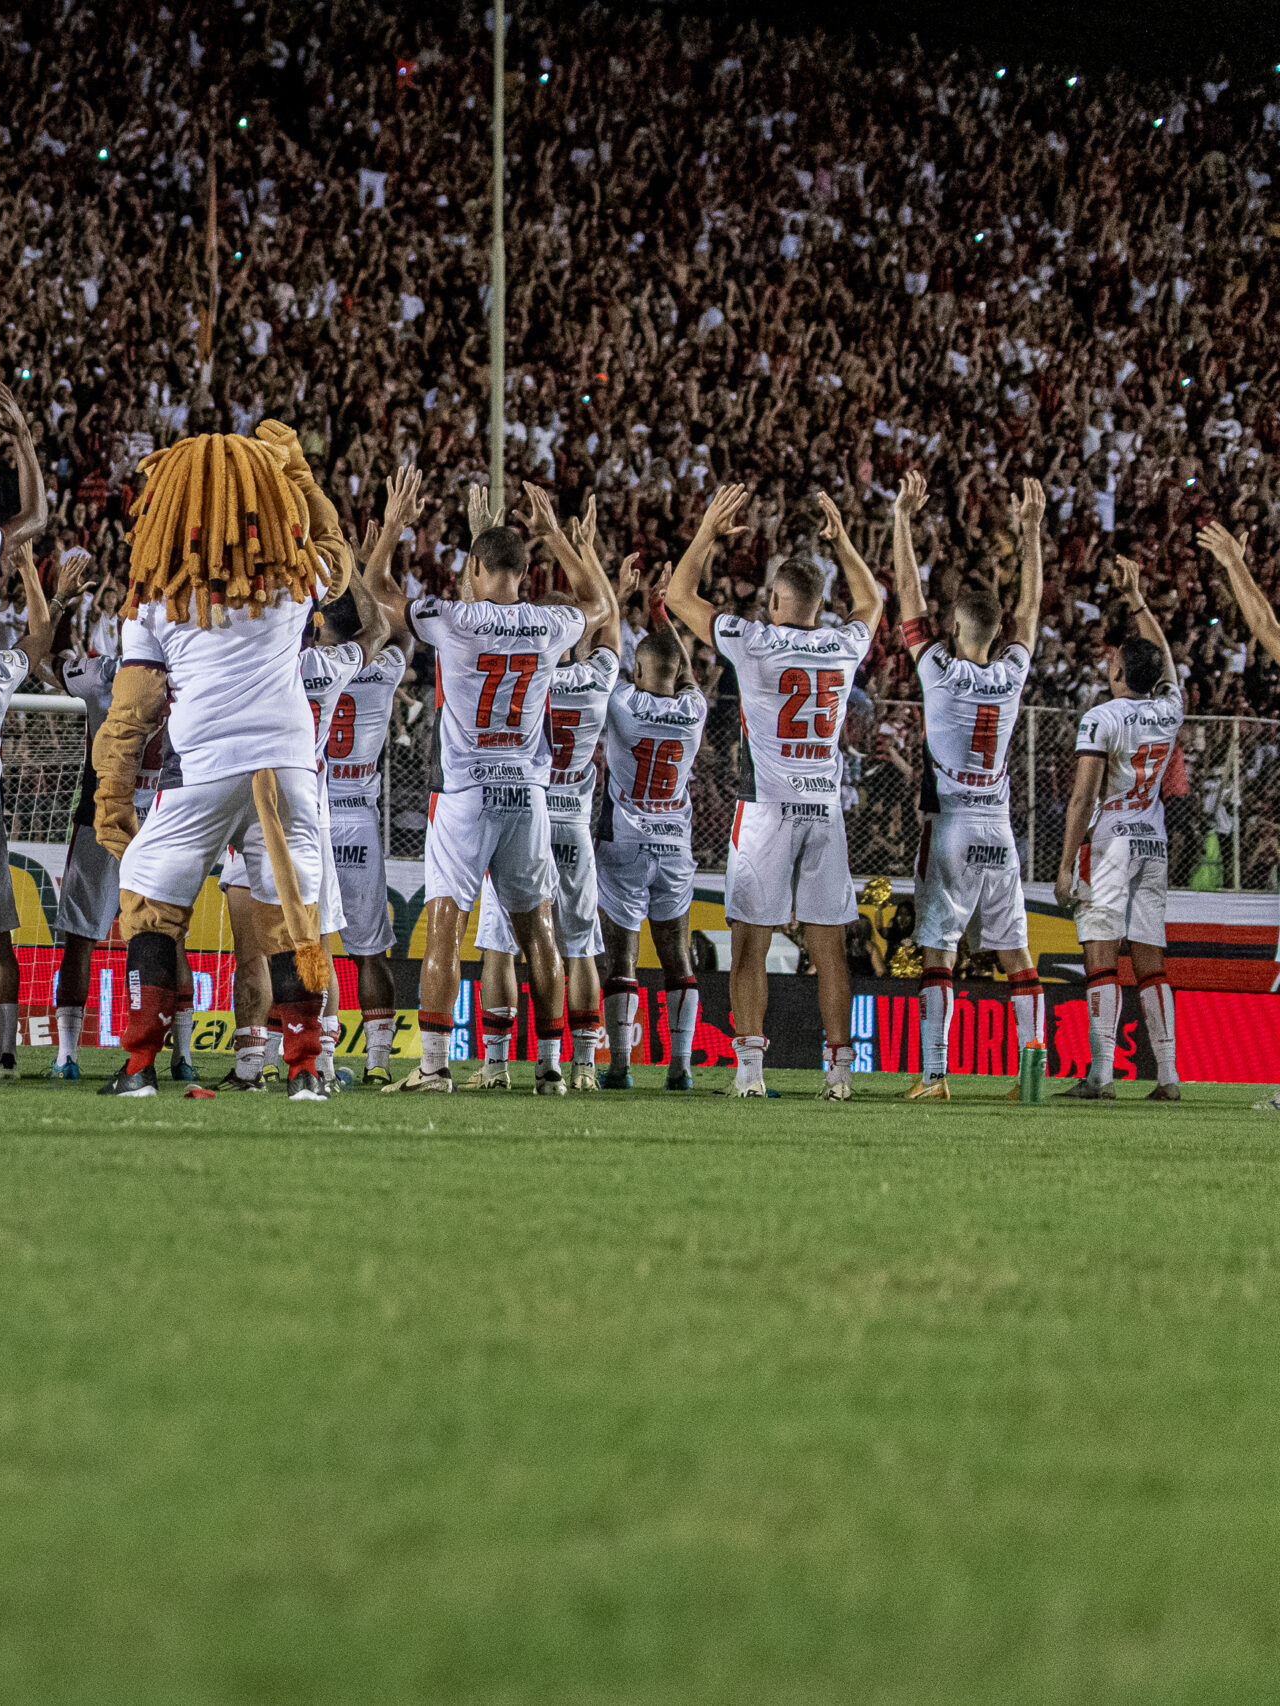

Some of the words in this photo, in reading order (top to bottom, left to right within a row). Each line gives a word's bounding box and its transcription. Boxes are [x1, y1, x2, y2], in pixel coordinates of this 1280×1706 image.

[494, 625, 548, 638] UniAGRO
[475, 653, 538, 728] 77
[777, 668, 845, 739] 25
[477, 732, 523, 747] NERIS
[488, 763, 524, 777] VITÓRIA
[631, 738, 684, 800] 16
[1126, 743, 1170, 800] 17
[482, 786, 531, 808] PRIME
[967, 844, 1008, 865] PRIME
[1129, 839, 1166, 859] PRIME
[128, 969, 142, 1010] UniBARTER
